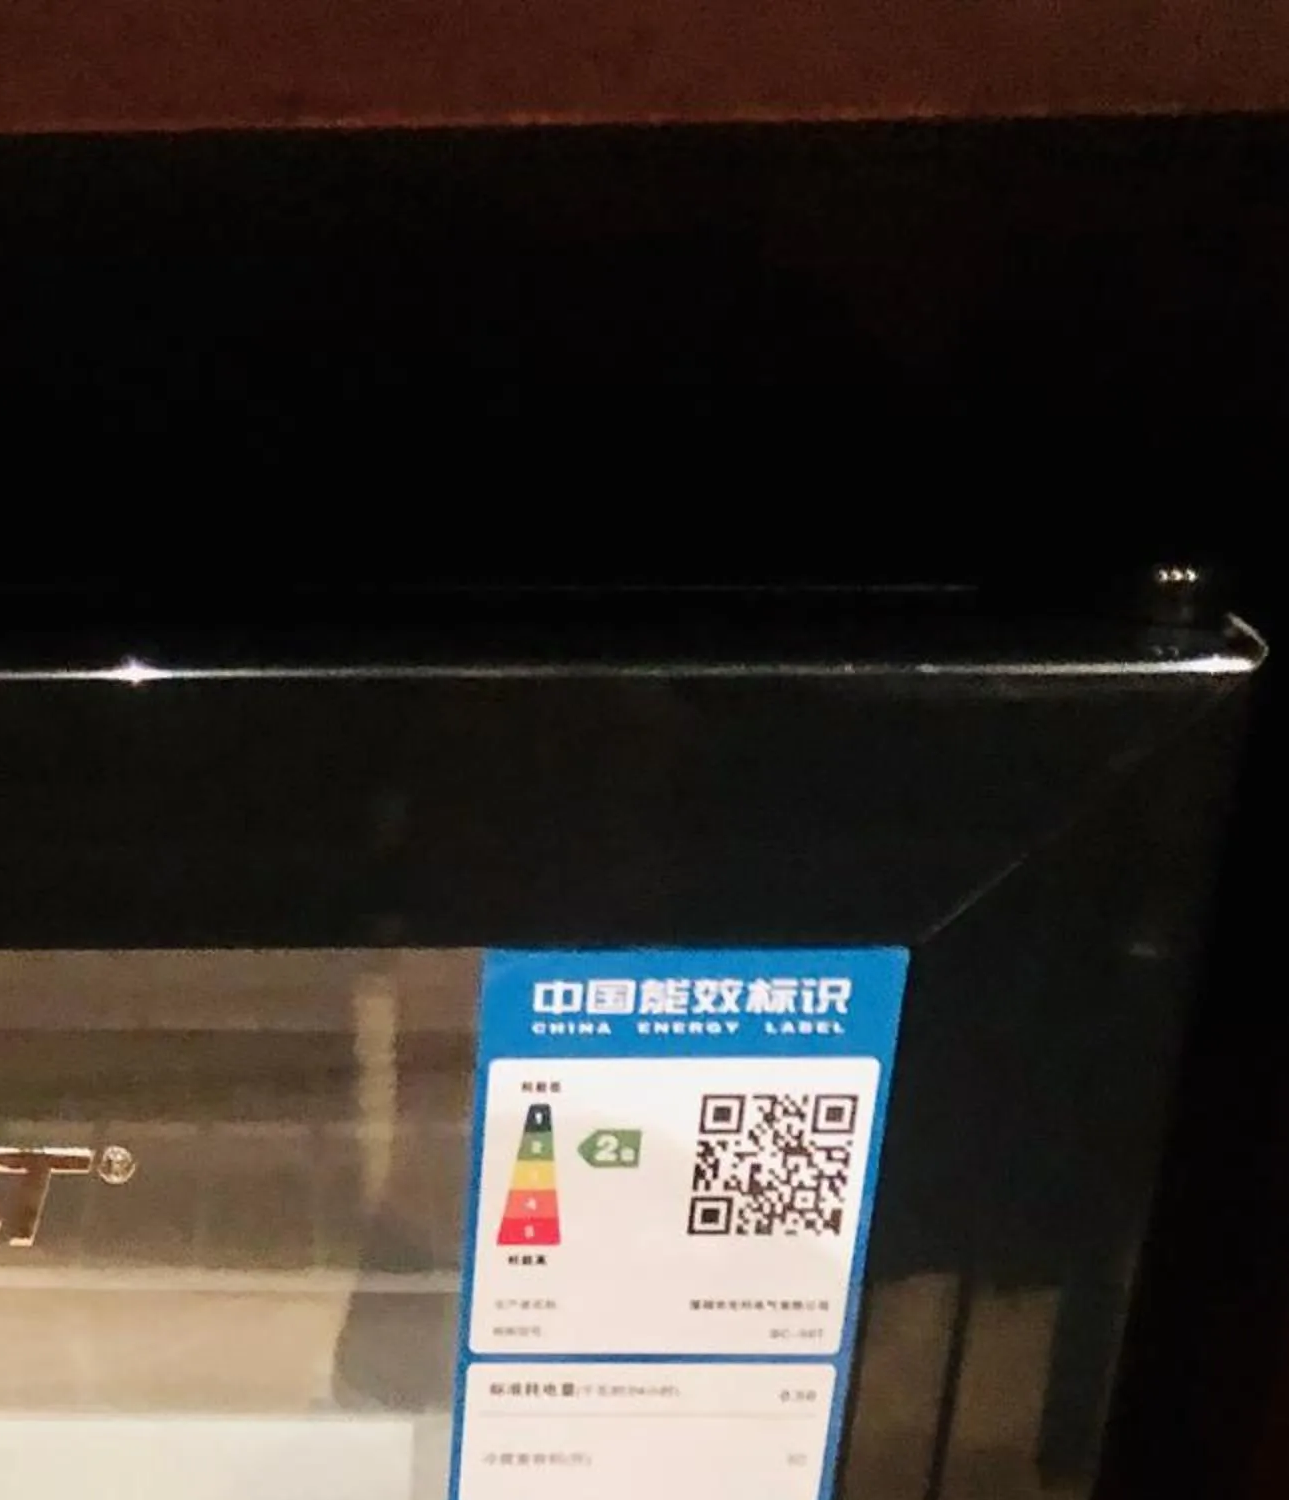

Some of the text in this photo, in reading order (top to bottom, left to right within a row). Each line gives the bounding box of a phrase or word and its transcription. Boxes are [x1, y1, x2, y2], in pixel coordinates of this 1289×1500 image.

[532, 977, 852, 1015] 中国能效标识
[531, 1021, 845, 1035] CHINA ENERGY LABEL
